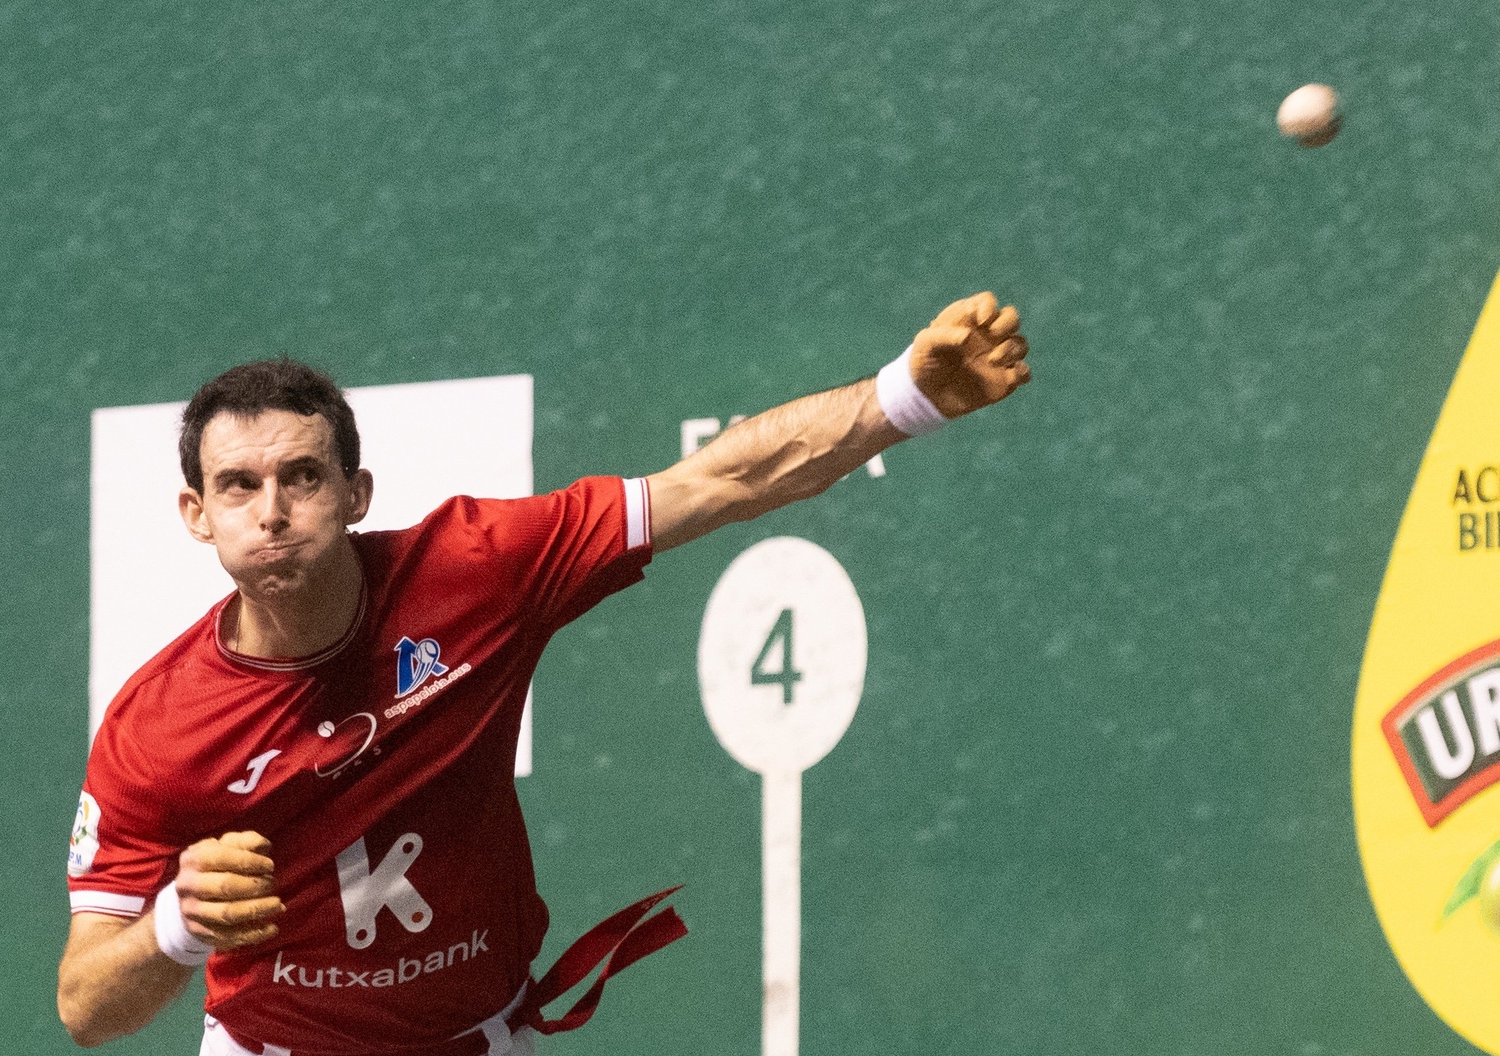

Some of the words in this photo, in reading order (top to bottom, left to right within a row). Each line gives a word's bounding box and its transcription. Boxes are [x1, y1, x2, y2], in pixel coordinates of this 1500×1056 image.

[1459, 511, 1500, 550] BI
[750, 608, 804, 704] 4
[383, 662, 472, 719] aspepelota.eus
[272, 928, 490, 988] kutxabank
